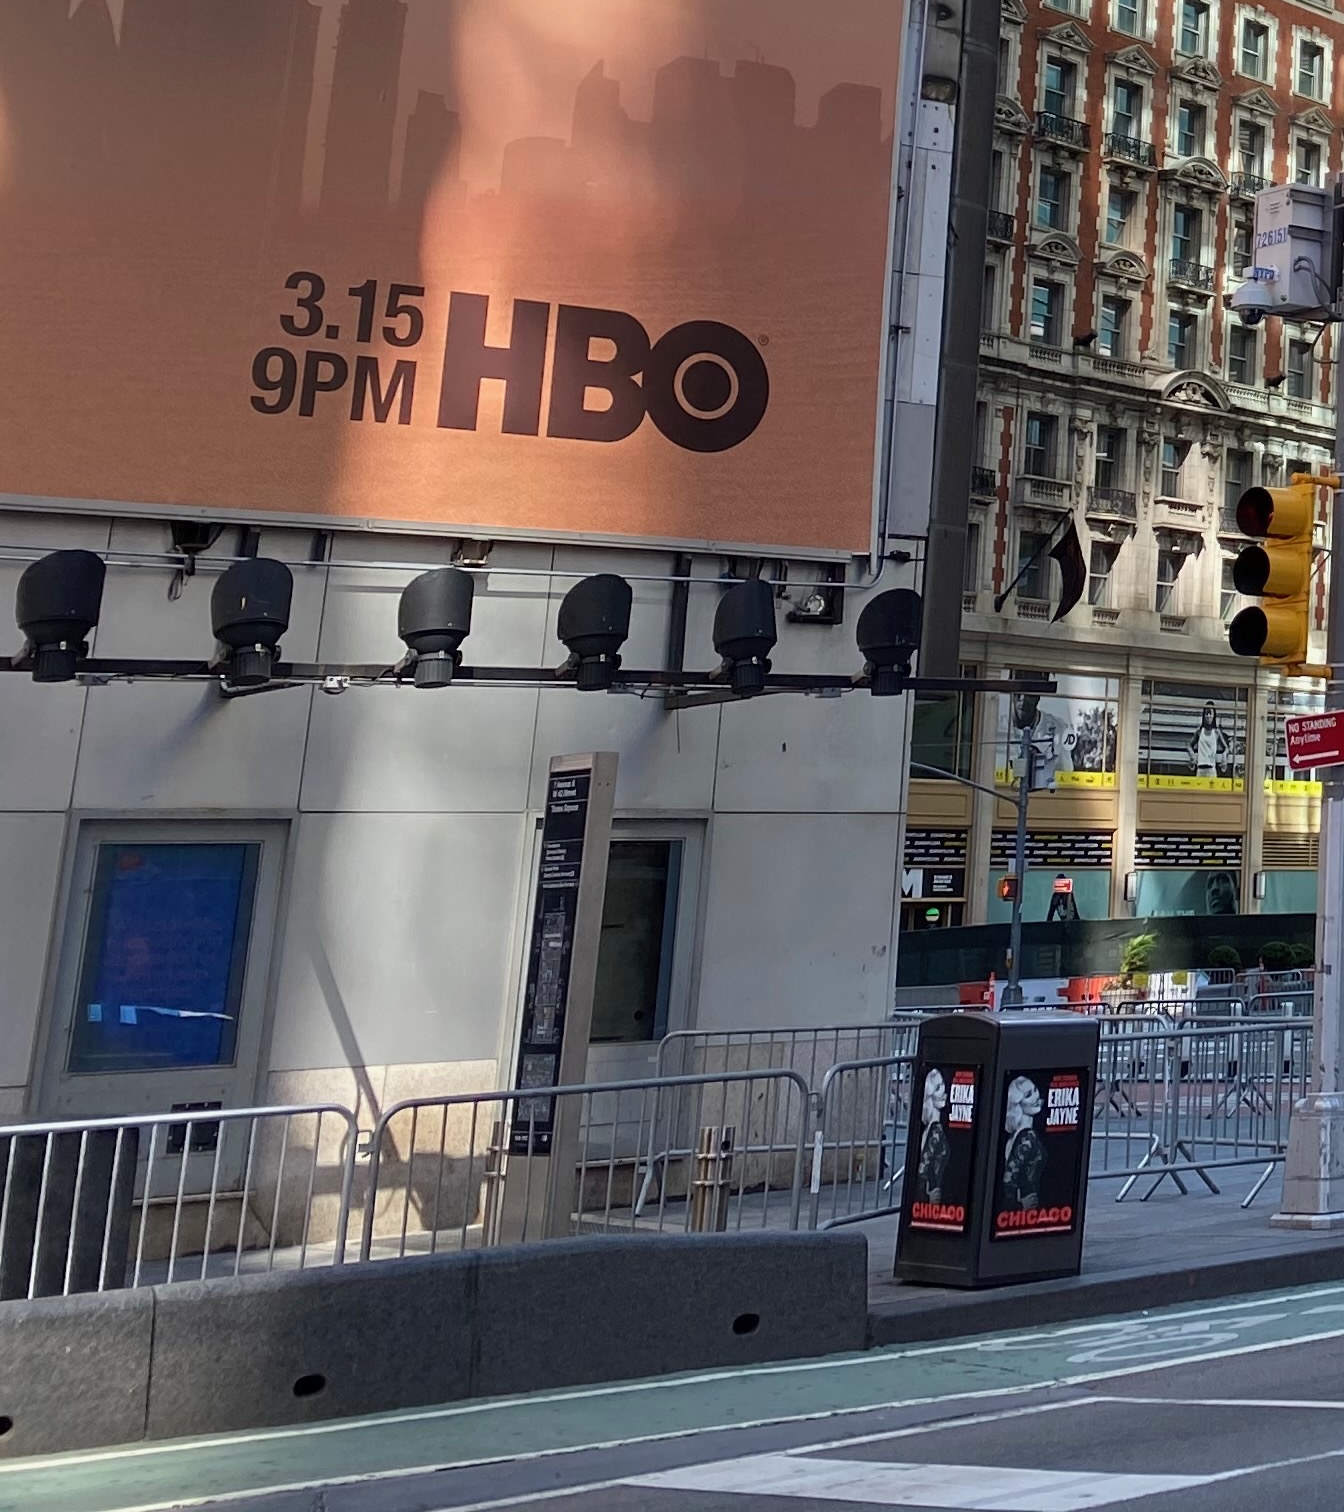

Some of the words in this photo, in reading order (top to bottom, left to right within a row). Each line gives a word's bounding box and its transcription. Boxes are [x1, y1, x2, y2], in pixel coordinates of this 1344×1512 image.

[280, 270, 426, 348] 3.15
[436, 290, 770, 453] HBO
[249, 347, 418, 427] 9PM
[1288, 723, 1300, 733] NO
[1302, 717, 1337, 732] STANDING
[1290, 732, 1321, 746] Anytime
[950, 1084, 974, 1104] ERIKA
[1048, 1087, 1080, 1108] ERIKA
[949, 1104, 973, 1122] JAYNE
[1046, 1107, 1079, 1125] JAYNE
[912, 1202, 965, 1222] CHICAGO
[997, 1206, 1072, 1227] CHICAGO
